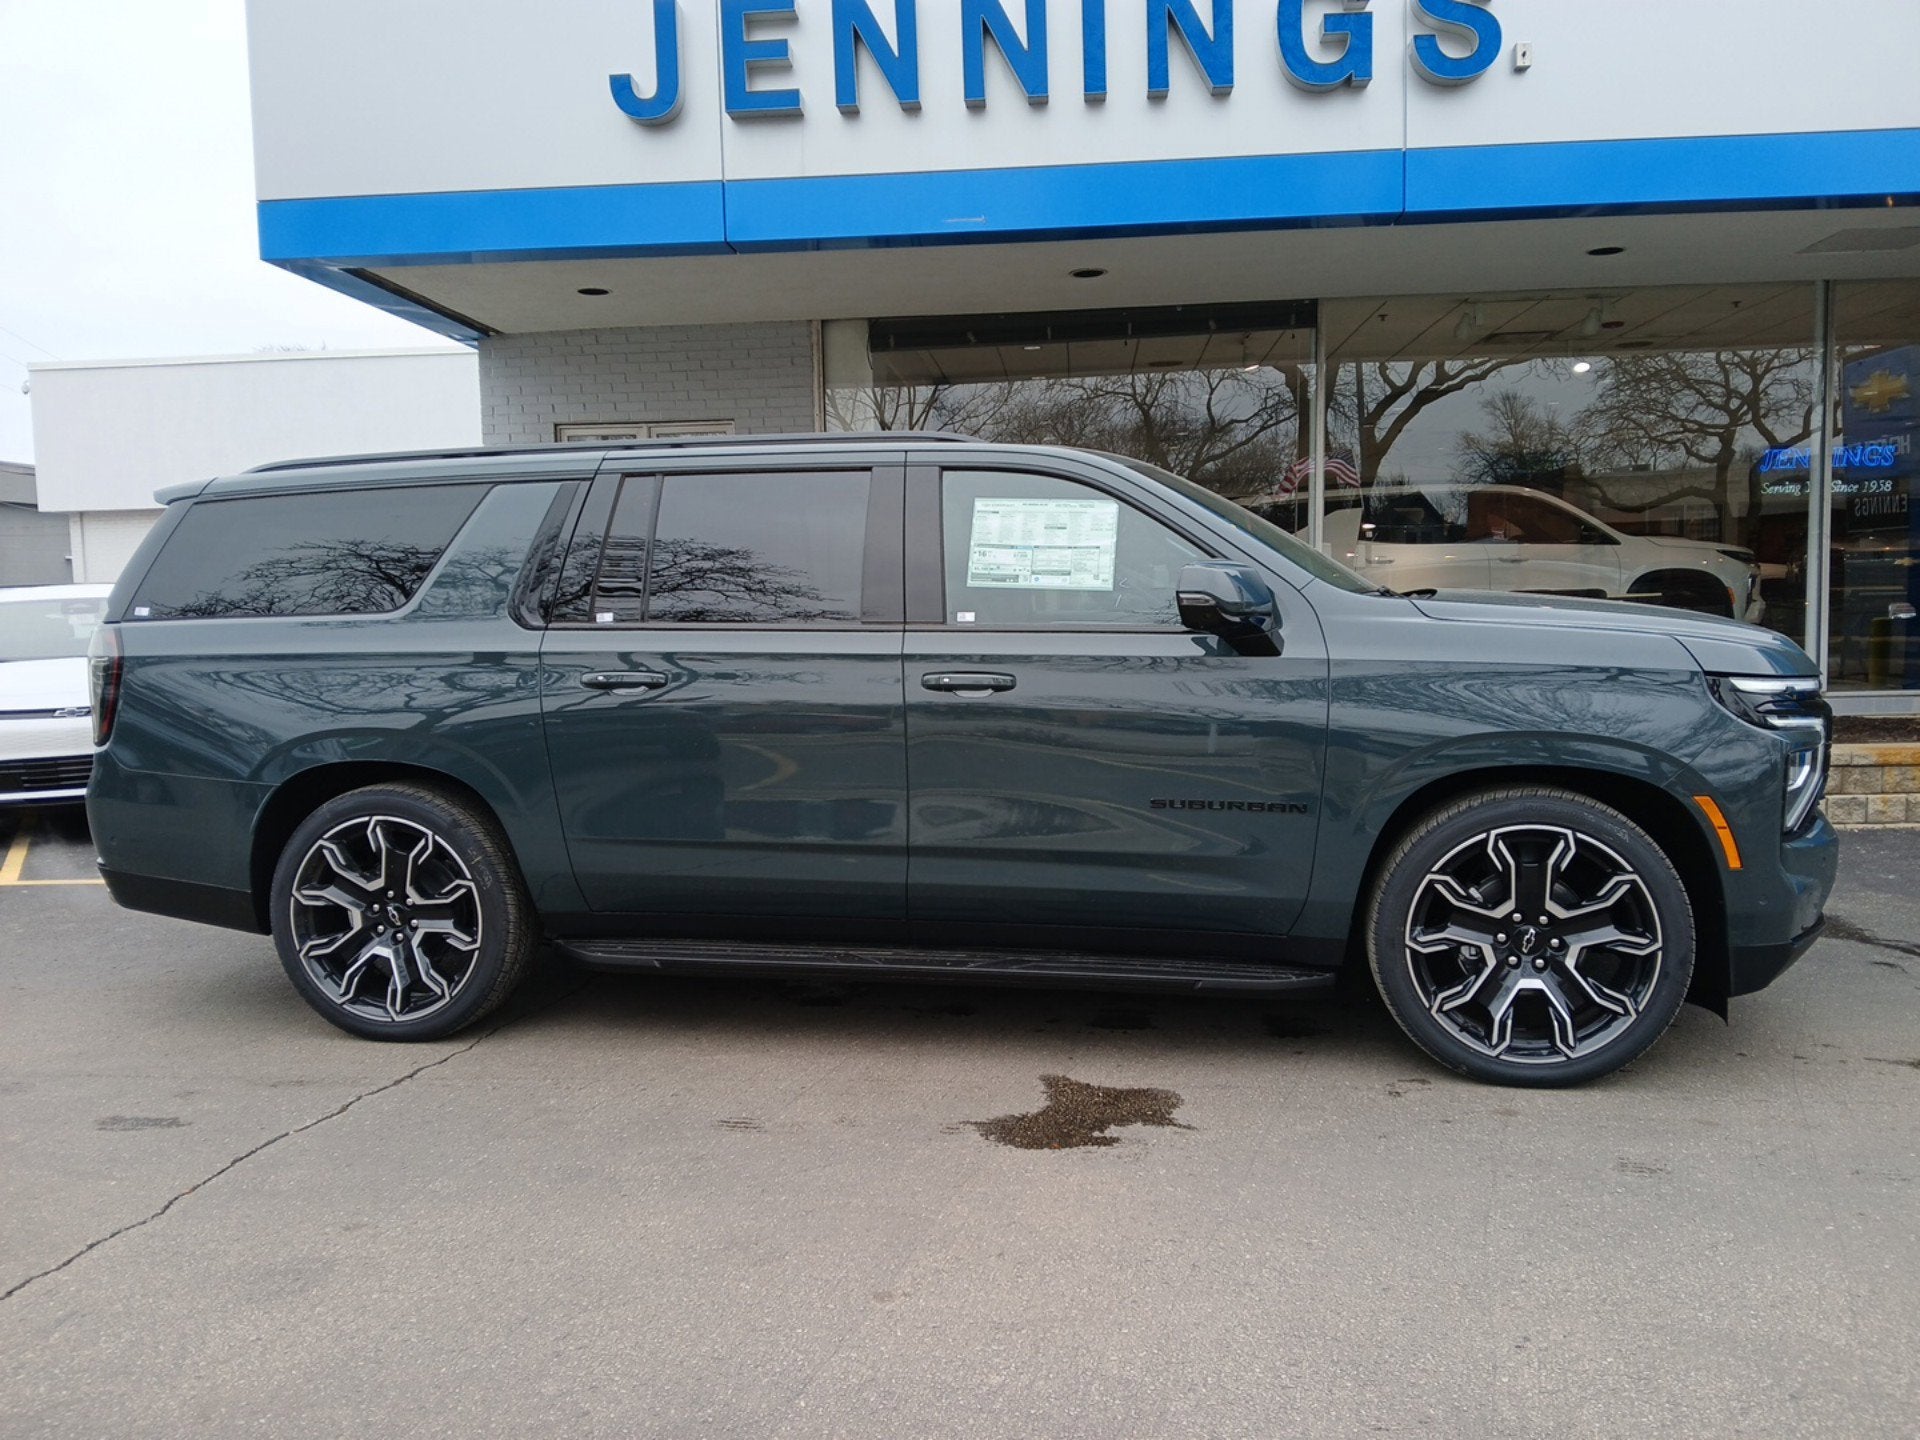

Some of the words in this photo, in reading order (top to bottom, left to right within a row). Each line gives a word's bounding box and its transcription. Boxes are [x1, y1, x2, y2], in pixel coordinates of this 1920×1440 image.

[609, 0, 1502, 121] JENNINGS
[1760, 445, 1896, 472] JENINGS
[1760, 481, 1801, 496] Serving
[1830, 479, 1859, 493] Since
[1862, 479, 1893, 493] 1958
[1150, 798, 1307, 814] SUBURBAN
